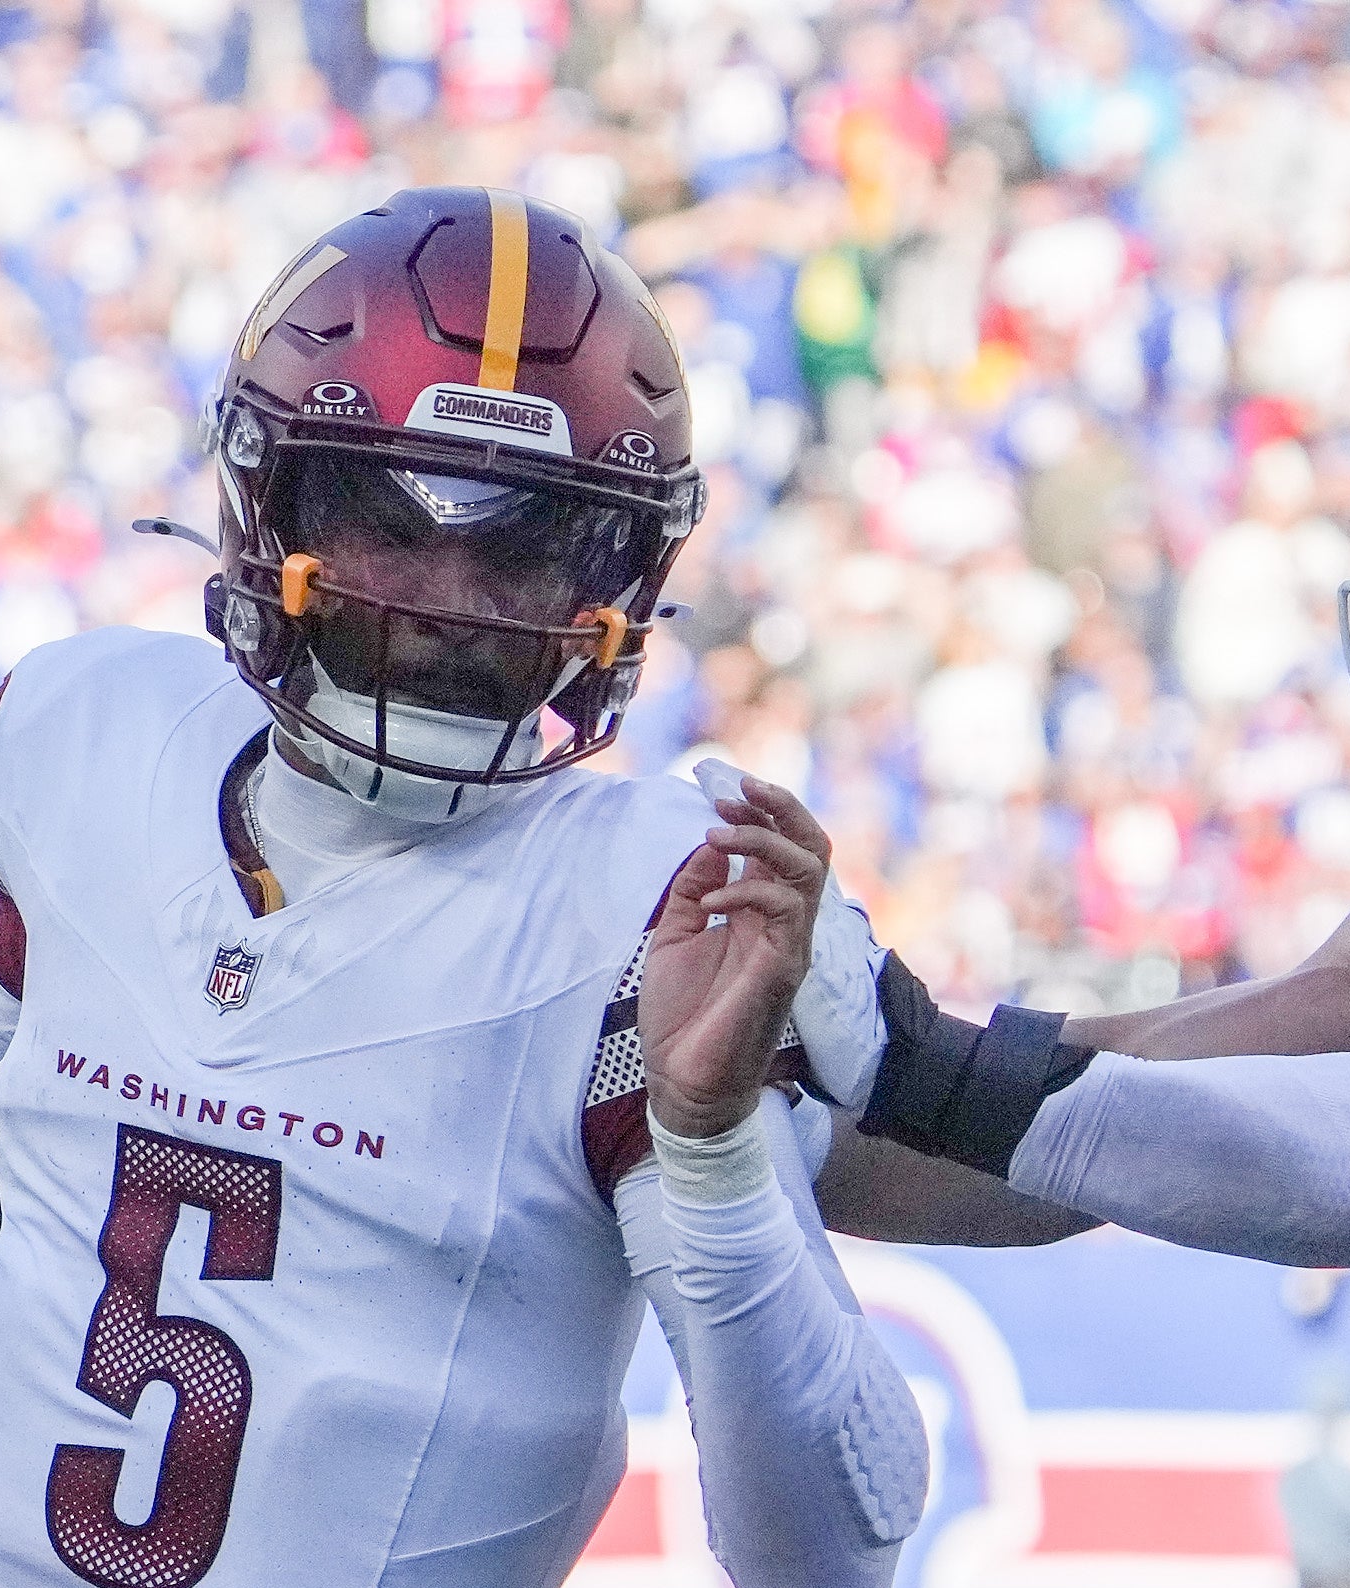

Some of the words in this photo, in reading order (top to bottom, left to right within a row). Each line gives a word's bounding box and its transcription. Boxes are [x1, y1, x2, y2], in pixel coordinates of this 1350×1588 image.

[303, 404, 367, 416] OAKLEY
[433, 394, 553, 431] COMMANDERS
[210, 969, 242, 1000] NFL
[56, 1048, 388, 1160] WASHINGTON
